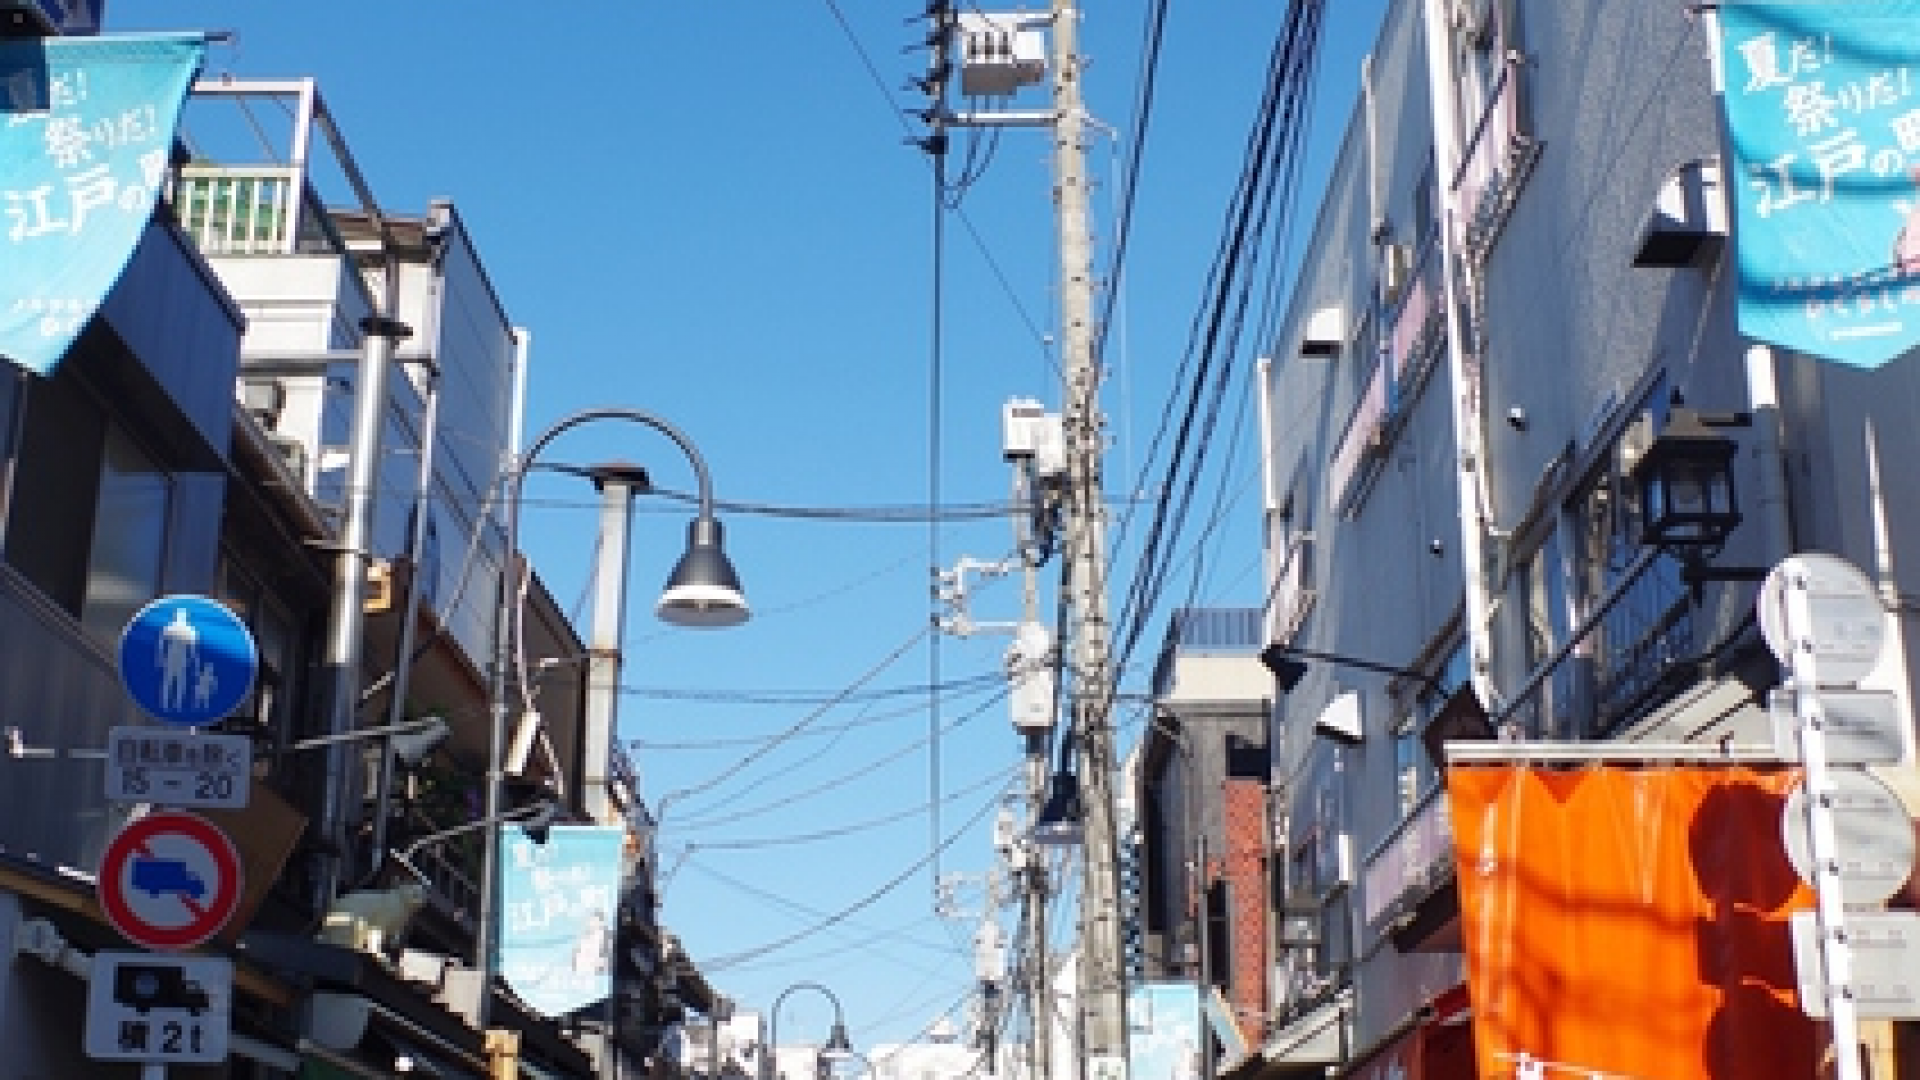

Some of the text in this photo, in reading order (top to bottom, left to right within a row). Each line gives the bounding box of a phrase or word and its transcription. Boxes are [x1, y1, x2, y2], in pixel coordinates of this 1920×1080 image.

[1736, 31, 1831, 95] 夏だ!
[1782, 67, 1911, 136] 祭りだ!
[45, 105, 156, 168] 祭りだ!
[195, 771, 233, 800] 20
